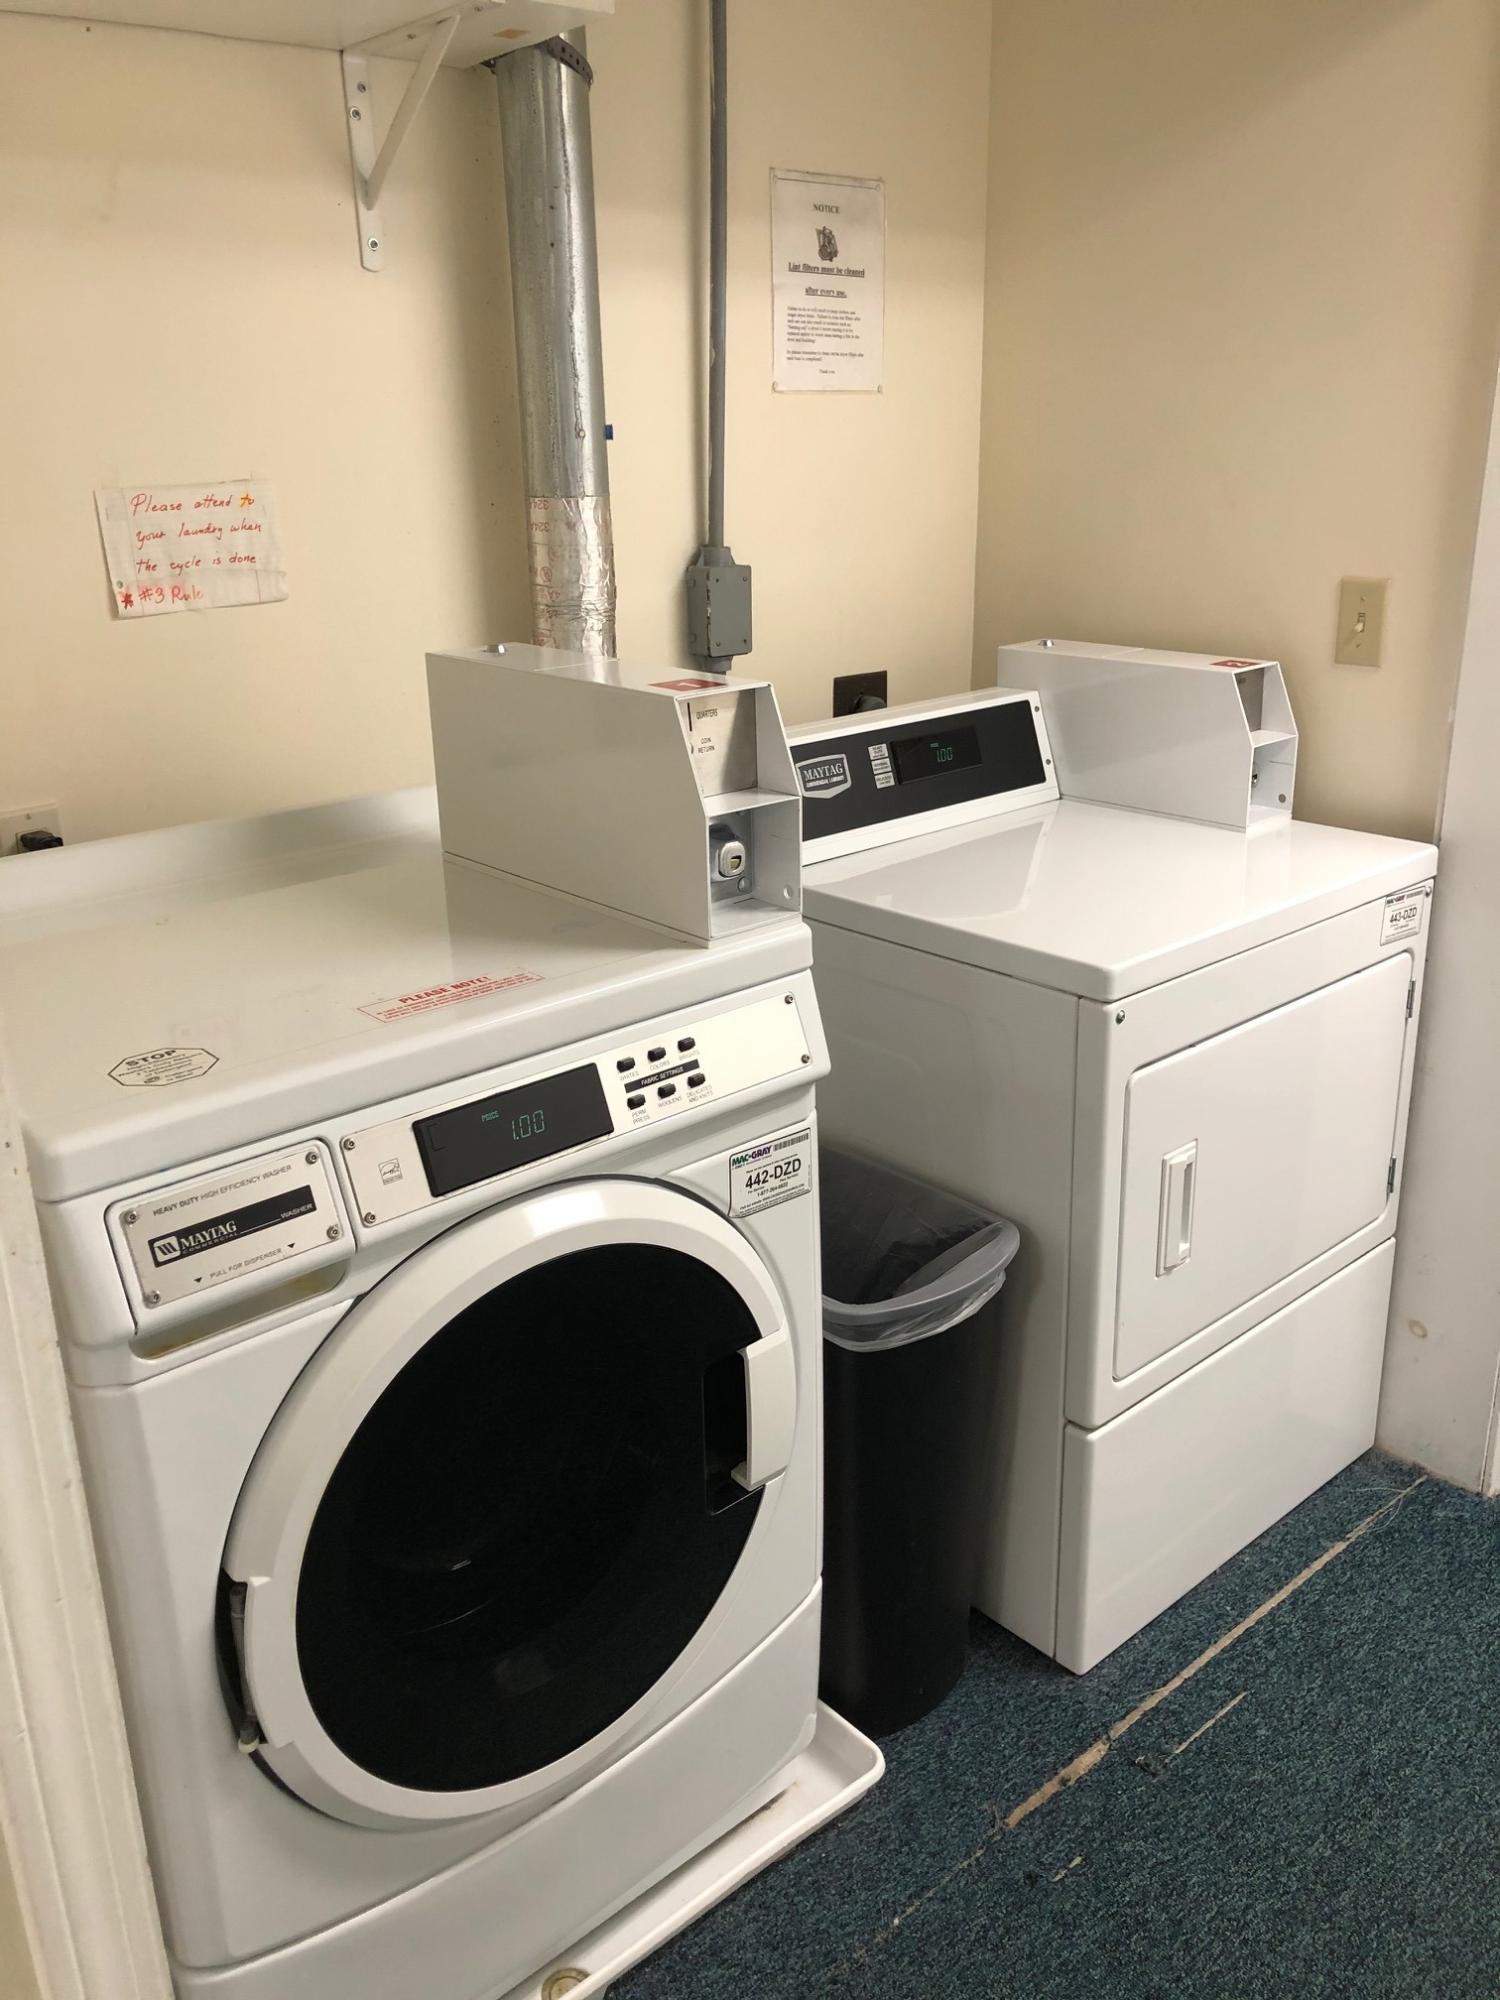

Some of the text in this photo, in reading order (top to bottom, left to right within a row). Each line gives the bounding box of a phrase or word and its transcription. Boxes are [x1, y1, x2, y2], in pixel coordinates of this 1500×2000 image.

[813, 203, 840, 214] NOTICE
[821, 266, 835, 275] must
[836, 266, 844, 276] be
[844, 267, 865, 278] cleaned
[130, 493, 255, 516] Please attend to
[136, 517, 262, 550] your laundry when
[136, 552, 257, 576] the cycle is done
[696, 708, 718, 720] QUARTERS
[802, 763, 843, 781] MAYTAG
[399, 987, 449, 1004] PLEASE
[450, 976, 492, 990] NOTE!
[125, 1050, 177, 1066] STOP
[641, 1075, 660, 1086] FABRIC
[512, 1110, 545, 1141] 1.00
[732, 1146, 772, 1166] MAC-GRAY
[745, 1158, 802, 1190] 442-DZD
[153, 1164, 292, 1216] HEAVY DUTY HIGH EFFICIENCY WASHER
[281, 1203, 313, 1219] WASHER
[181, 1220, 237, 1249] MAYTAG
[210, 1248, 282, 1279] PULL FOR DISPENSER
